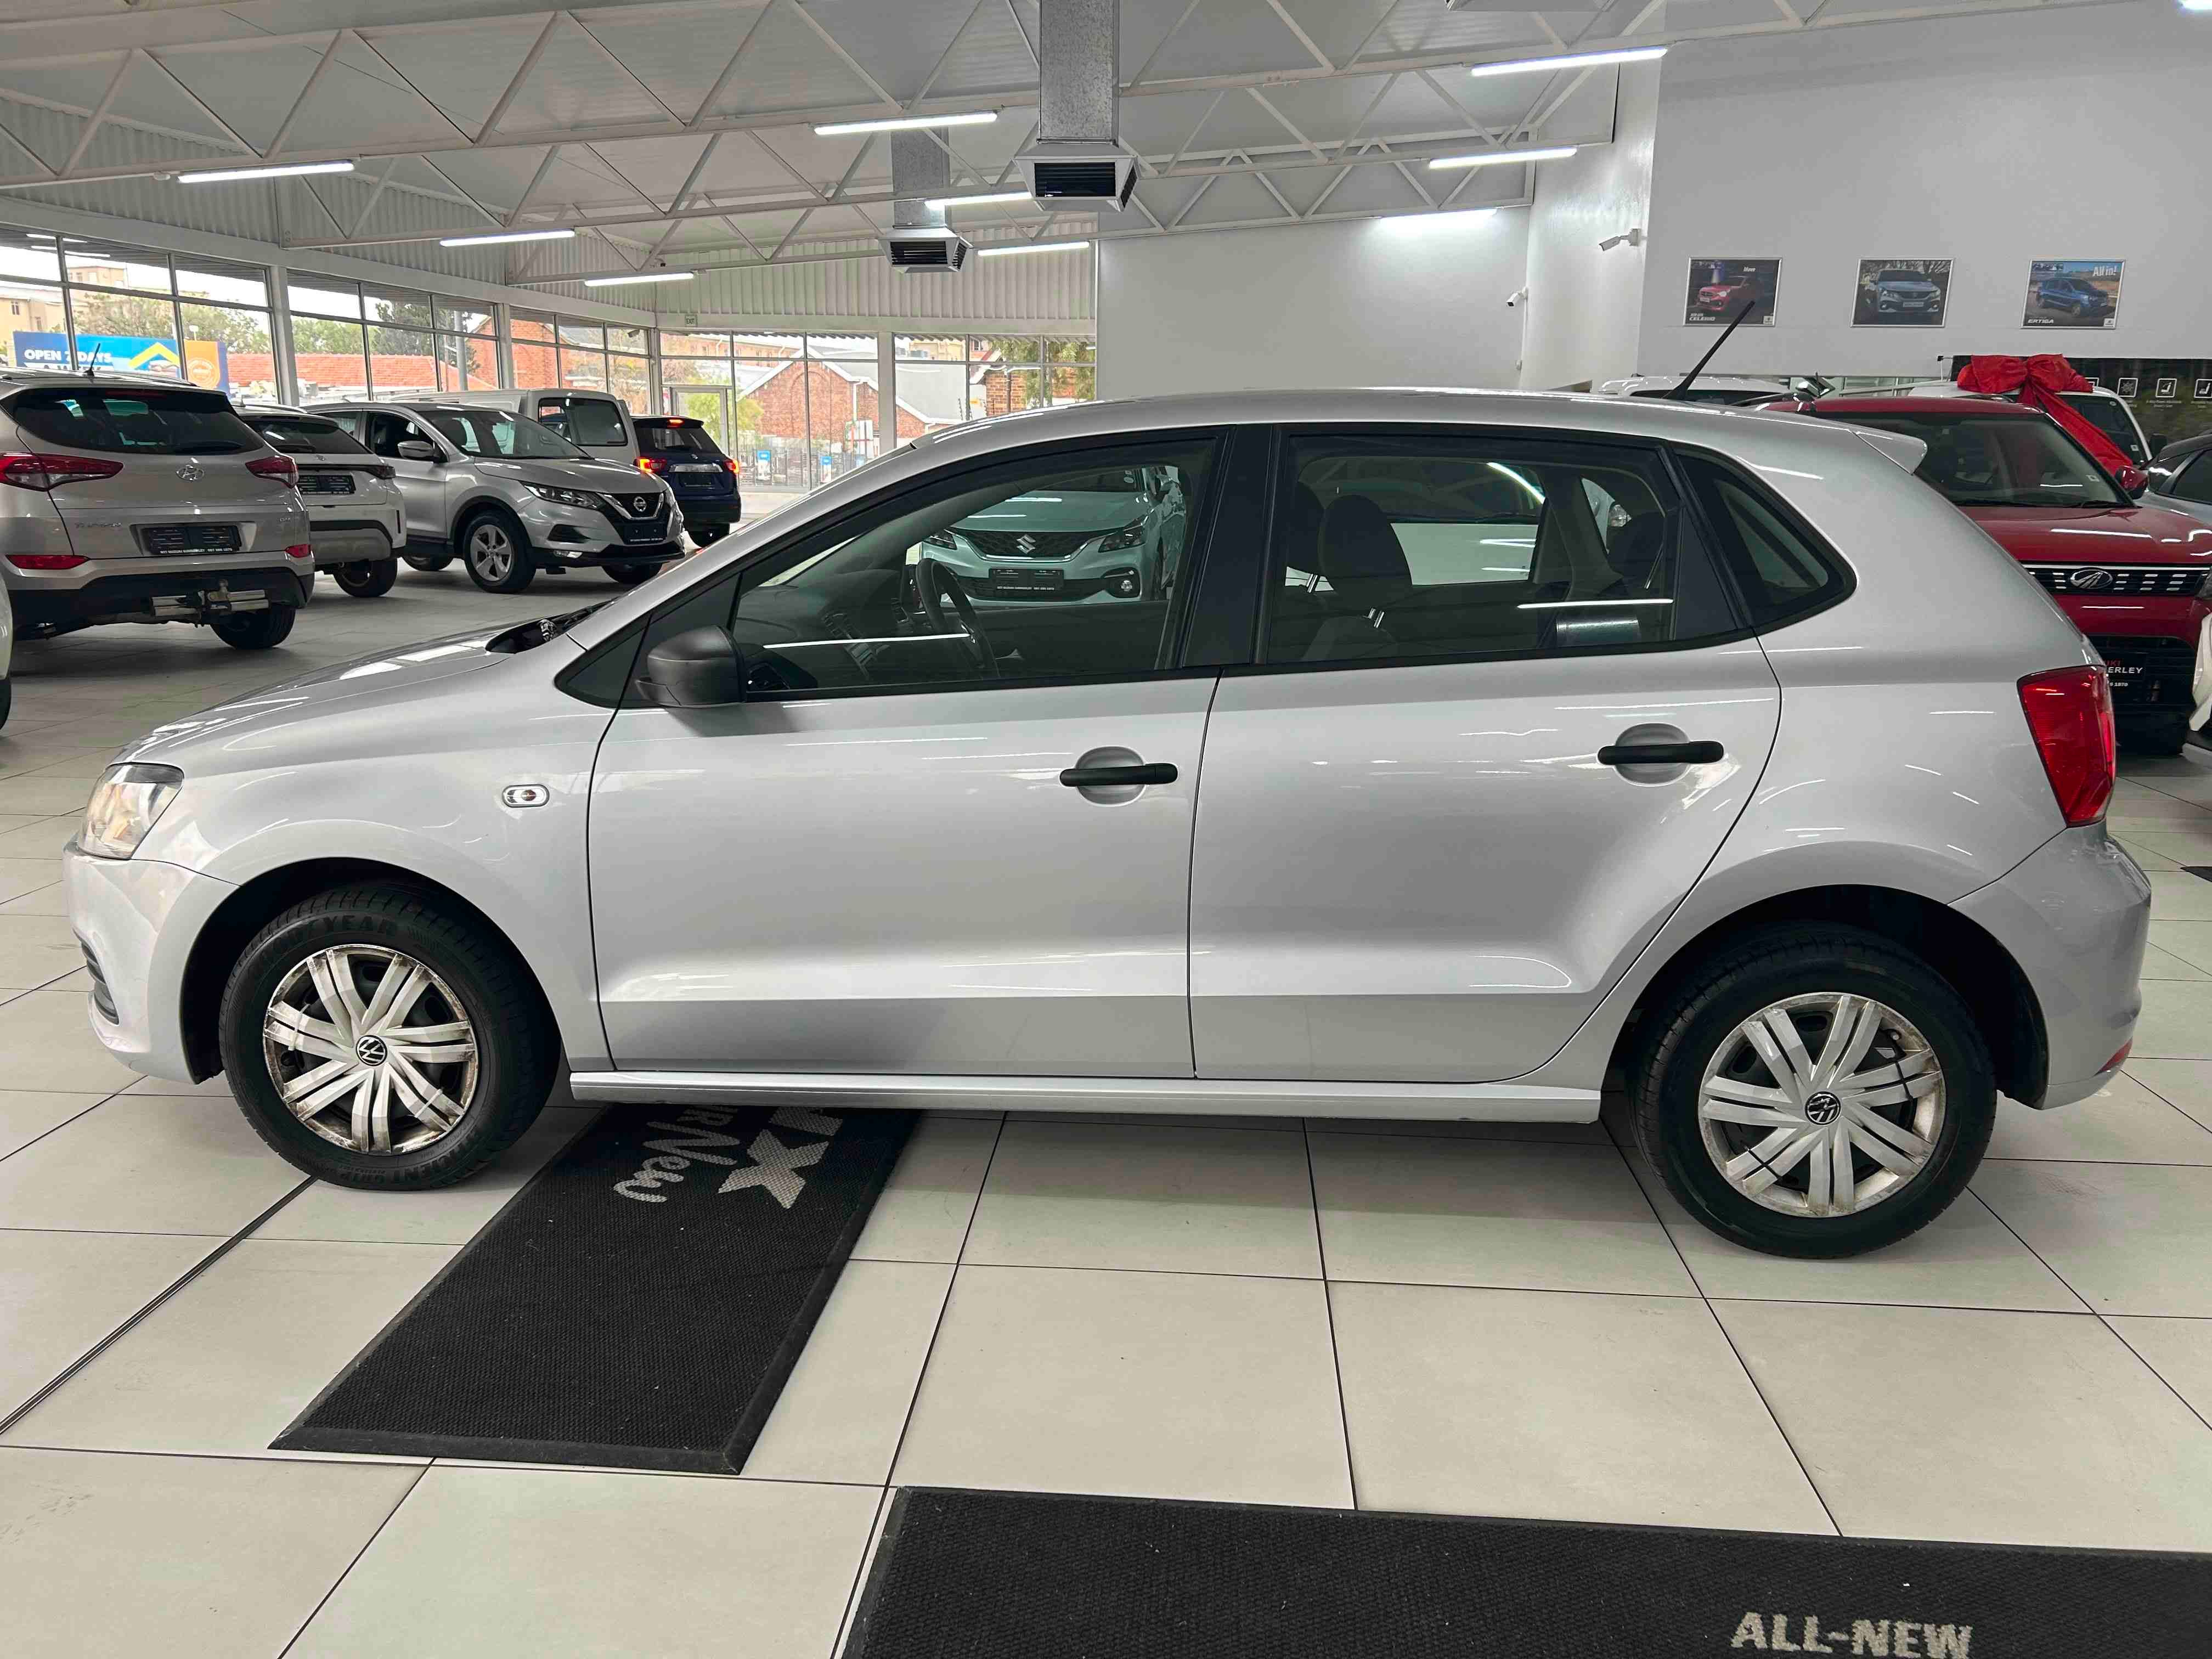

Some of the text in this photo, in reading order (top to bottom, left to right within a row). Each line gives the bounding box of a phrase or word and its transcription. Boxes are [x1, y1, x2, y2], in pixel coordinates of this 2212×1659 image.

[24, 349, 61, 360] OPEN
[79, 352, 112, 363] DAYS
[1731, 1611, 1973, 1659] ALL-NEW
